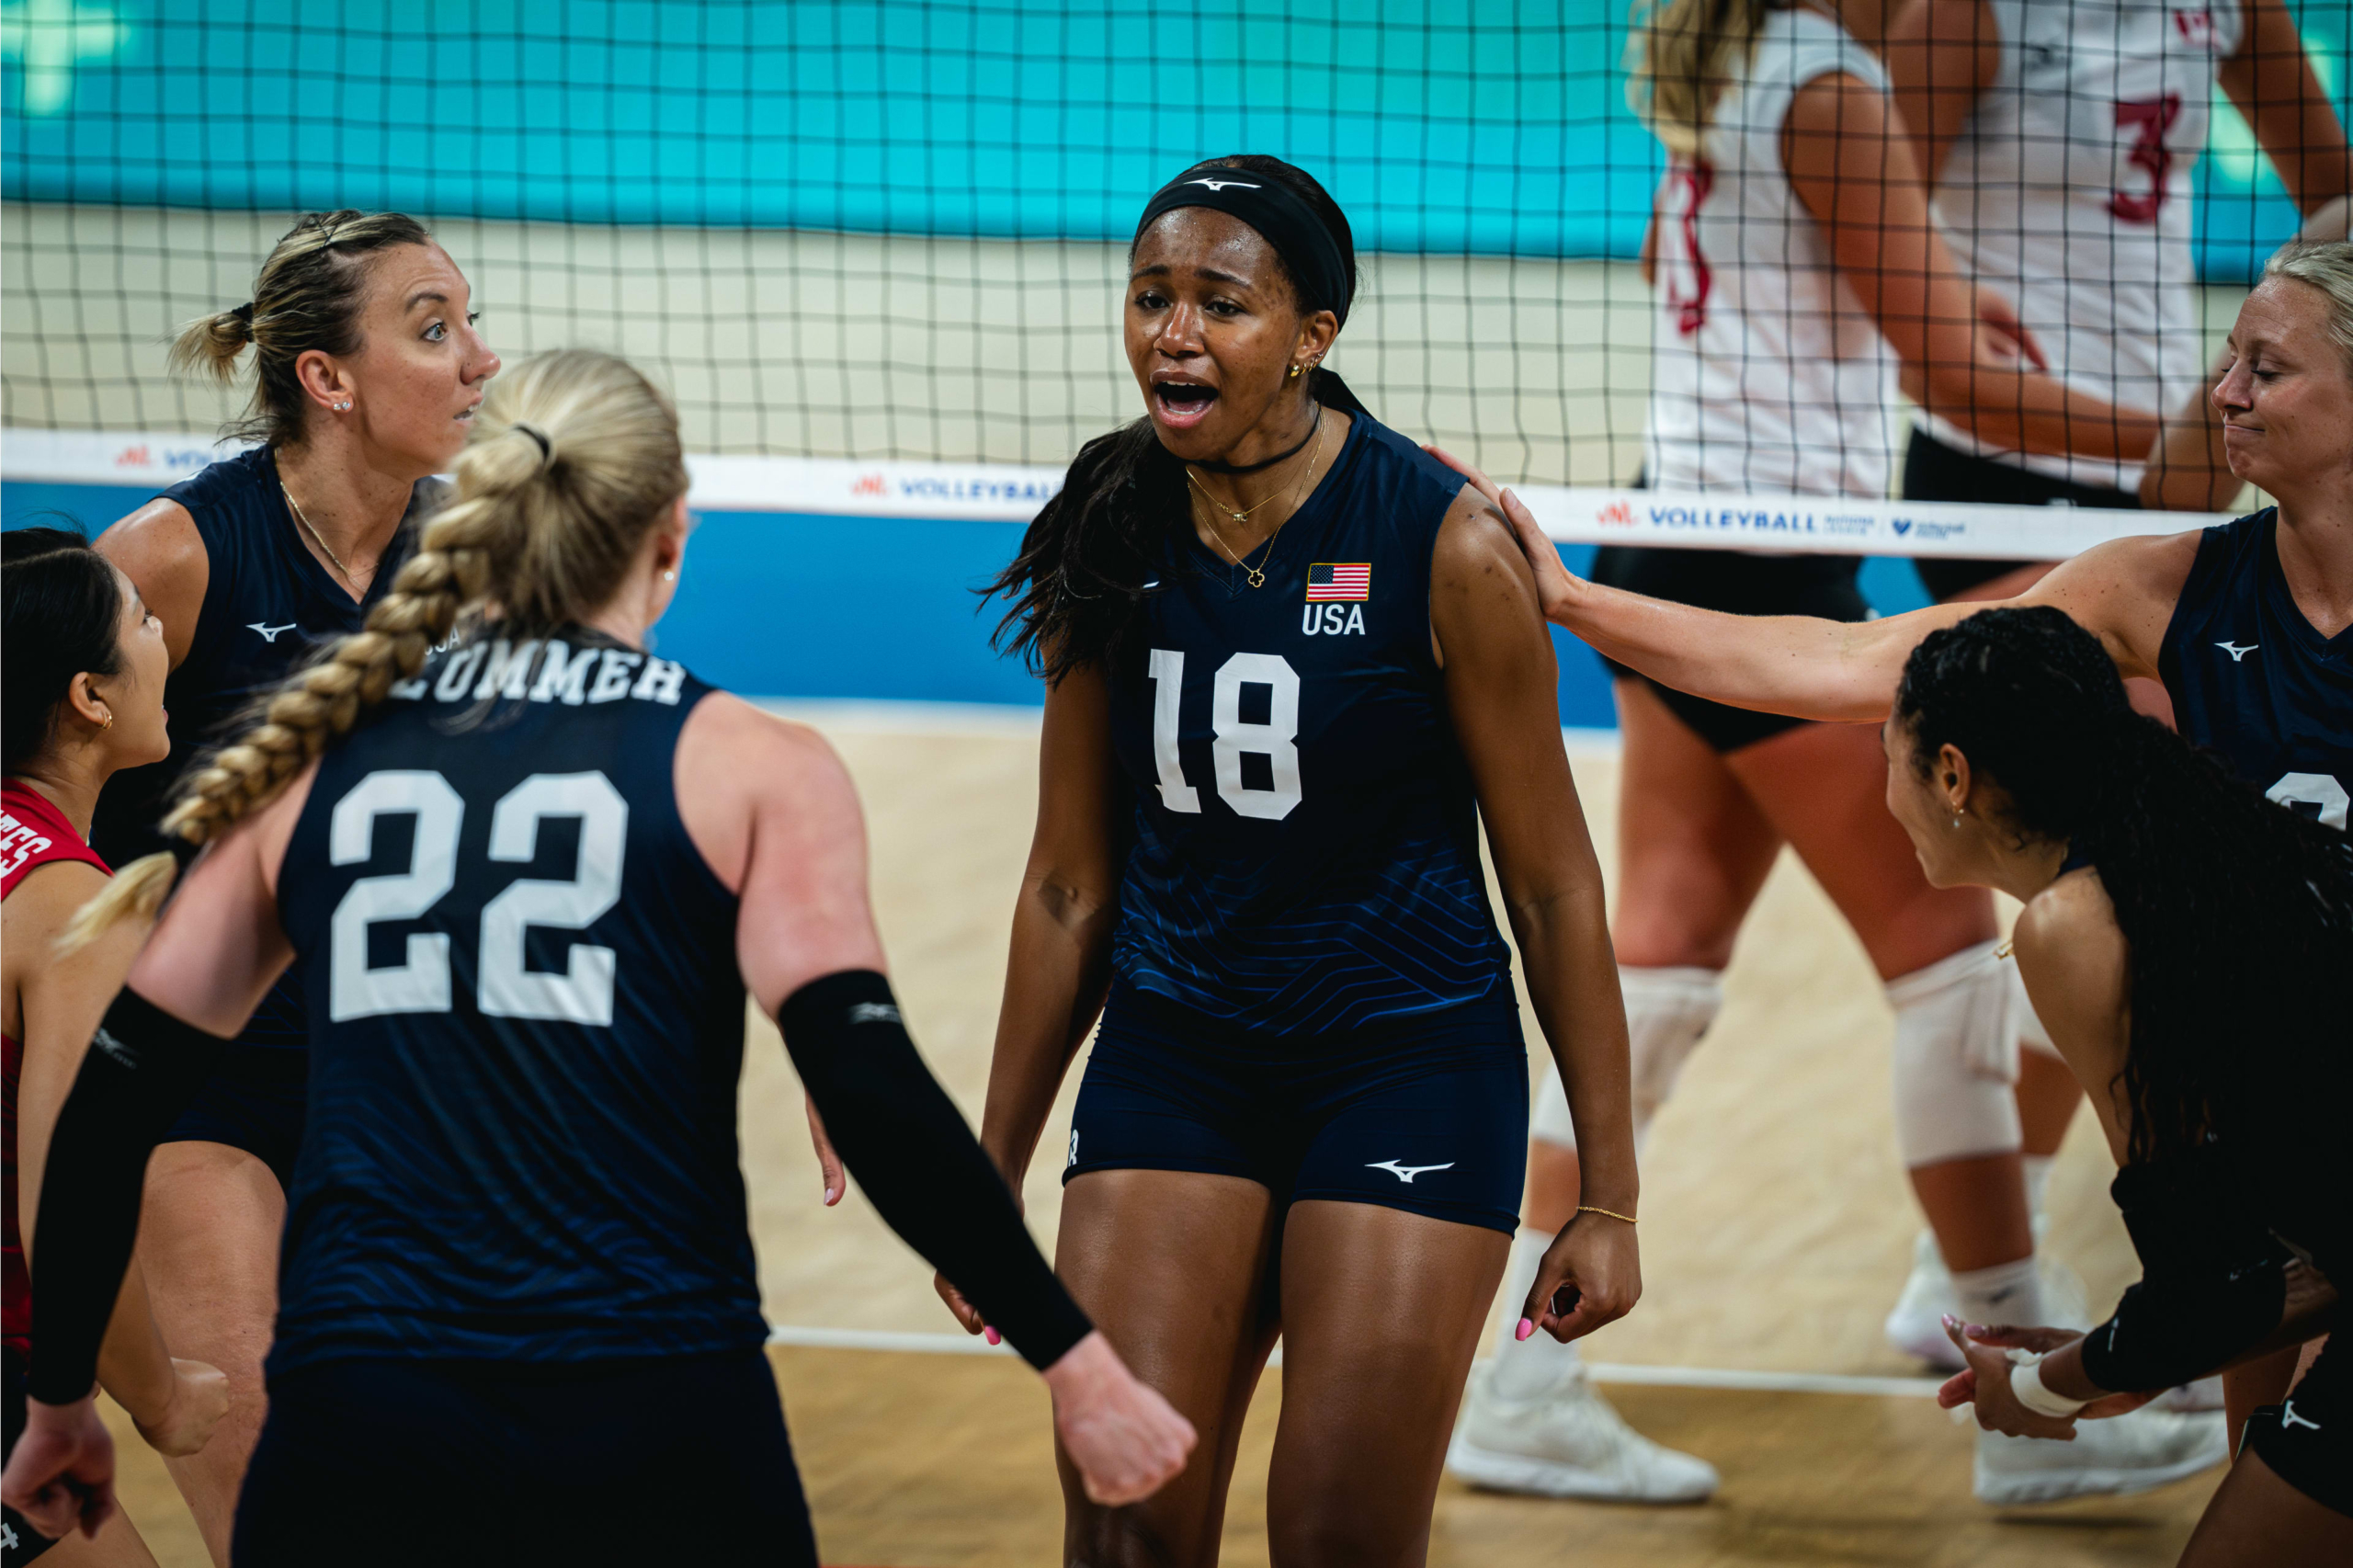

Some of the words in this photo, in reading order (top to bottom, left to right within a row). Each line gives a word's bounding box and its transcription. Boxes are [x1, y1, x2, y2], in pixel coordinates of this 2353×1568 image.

[2105, 91, 2181, 223] 3
[1650, 506, 1816, 533] VOLLEYBALL
[1302, 603, 1366, 636] USA
[1148, 648, 1302, 821] 18
[329, 769, 630, 1028] 22
